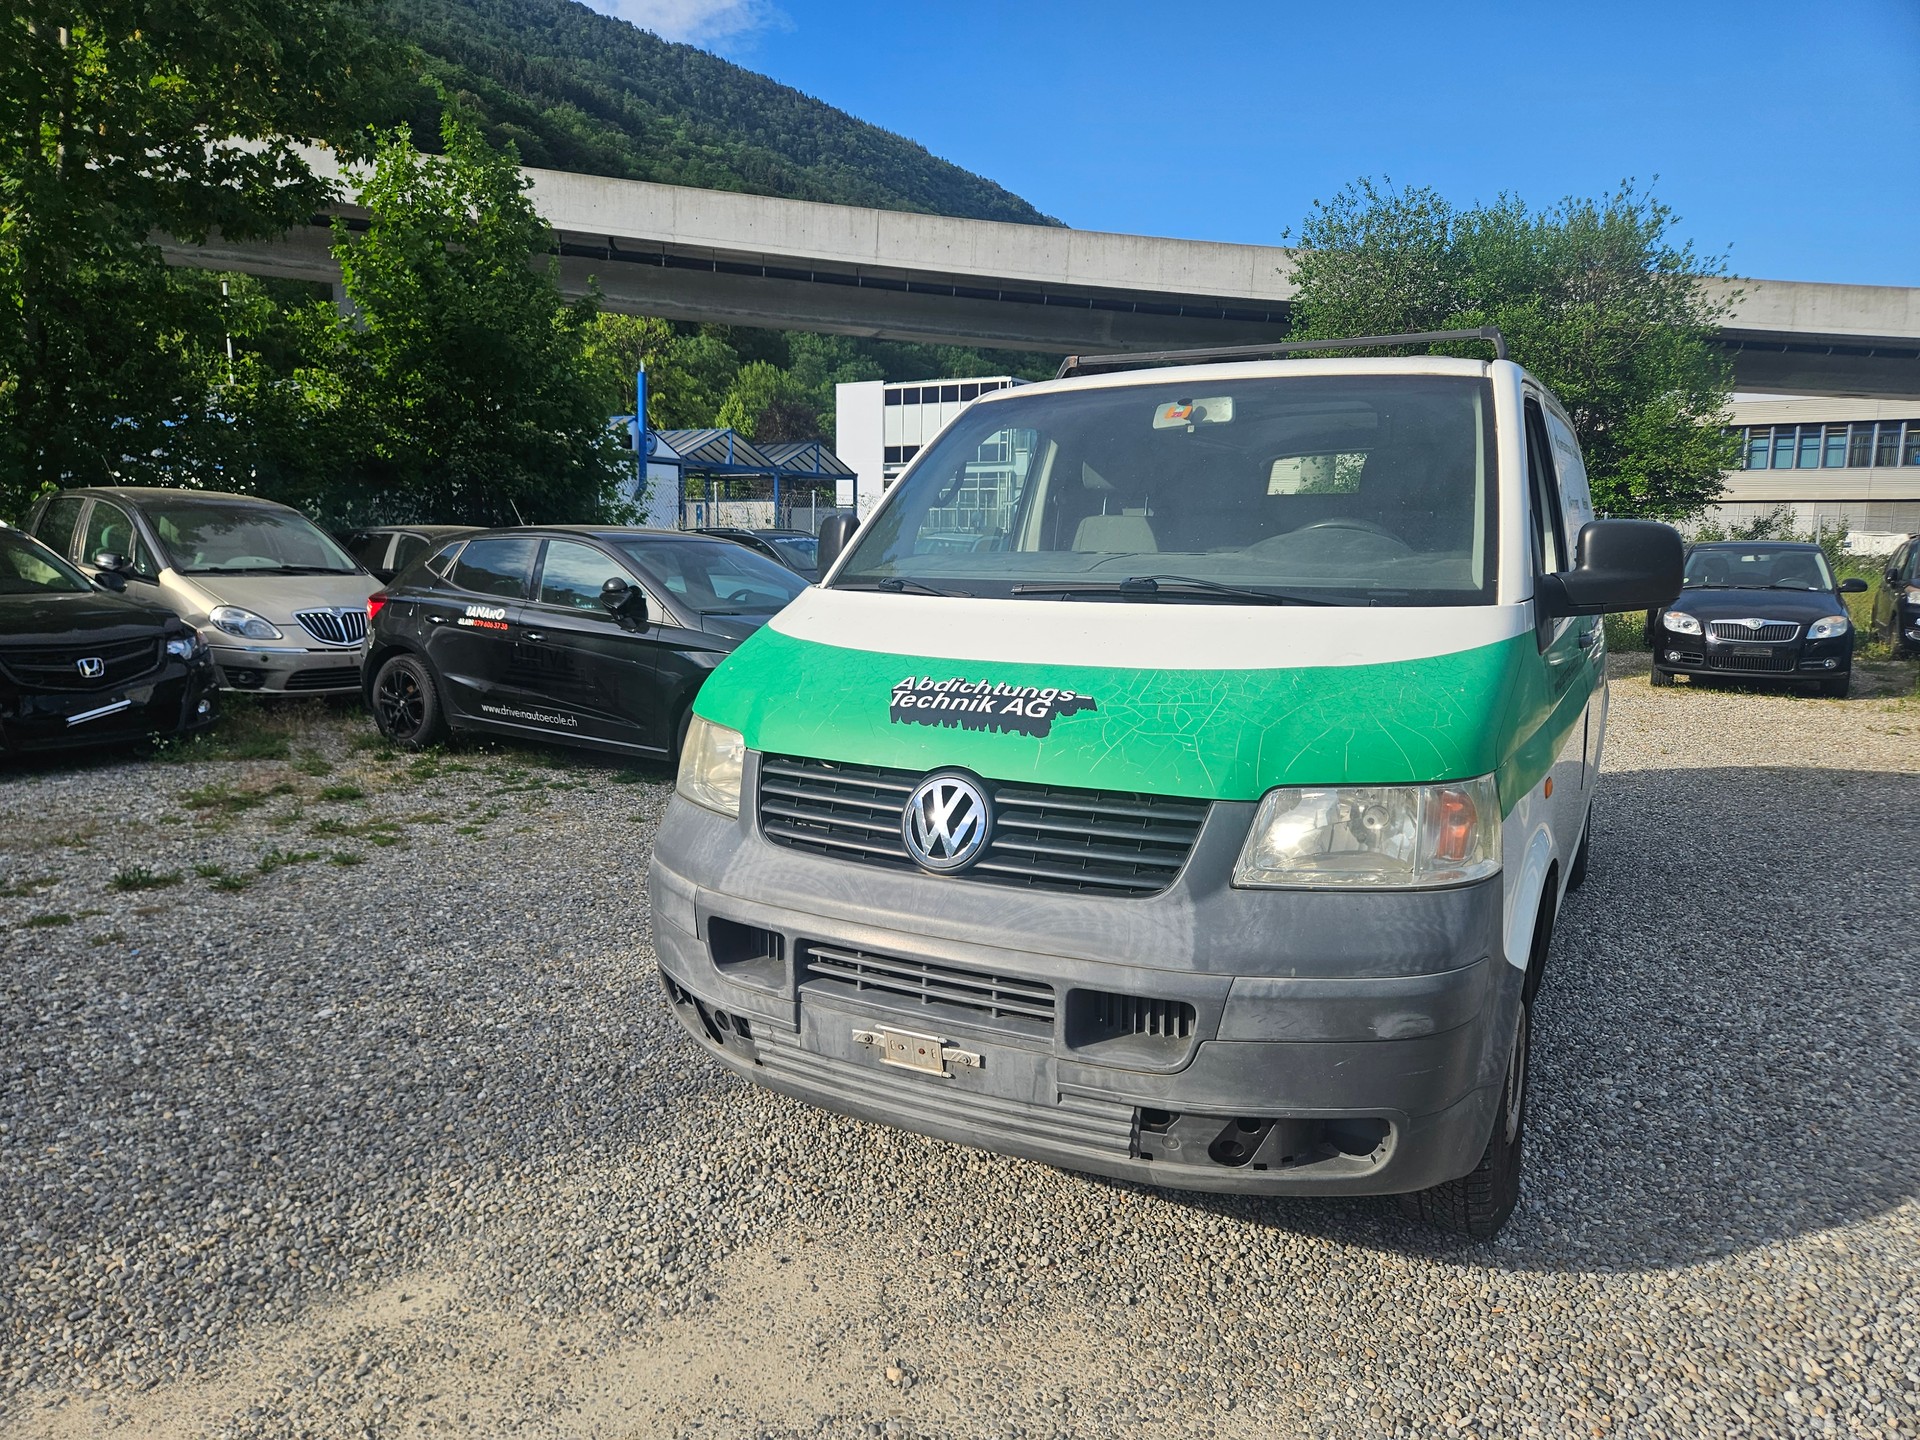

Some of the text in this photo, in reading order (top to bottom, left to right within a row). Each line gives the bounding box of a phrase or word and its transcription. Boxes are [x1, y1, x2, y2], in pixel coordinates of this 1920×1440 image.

[892, 676, 1094, 702] Abdichtungs-
[481, 704, 578, 728] www.driveinautoecole.ch
[890, 690, 1053, 719] Technik AG
[905, 778, 986, 868] VW
